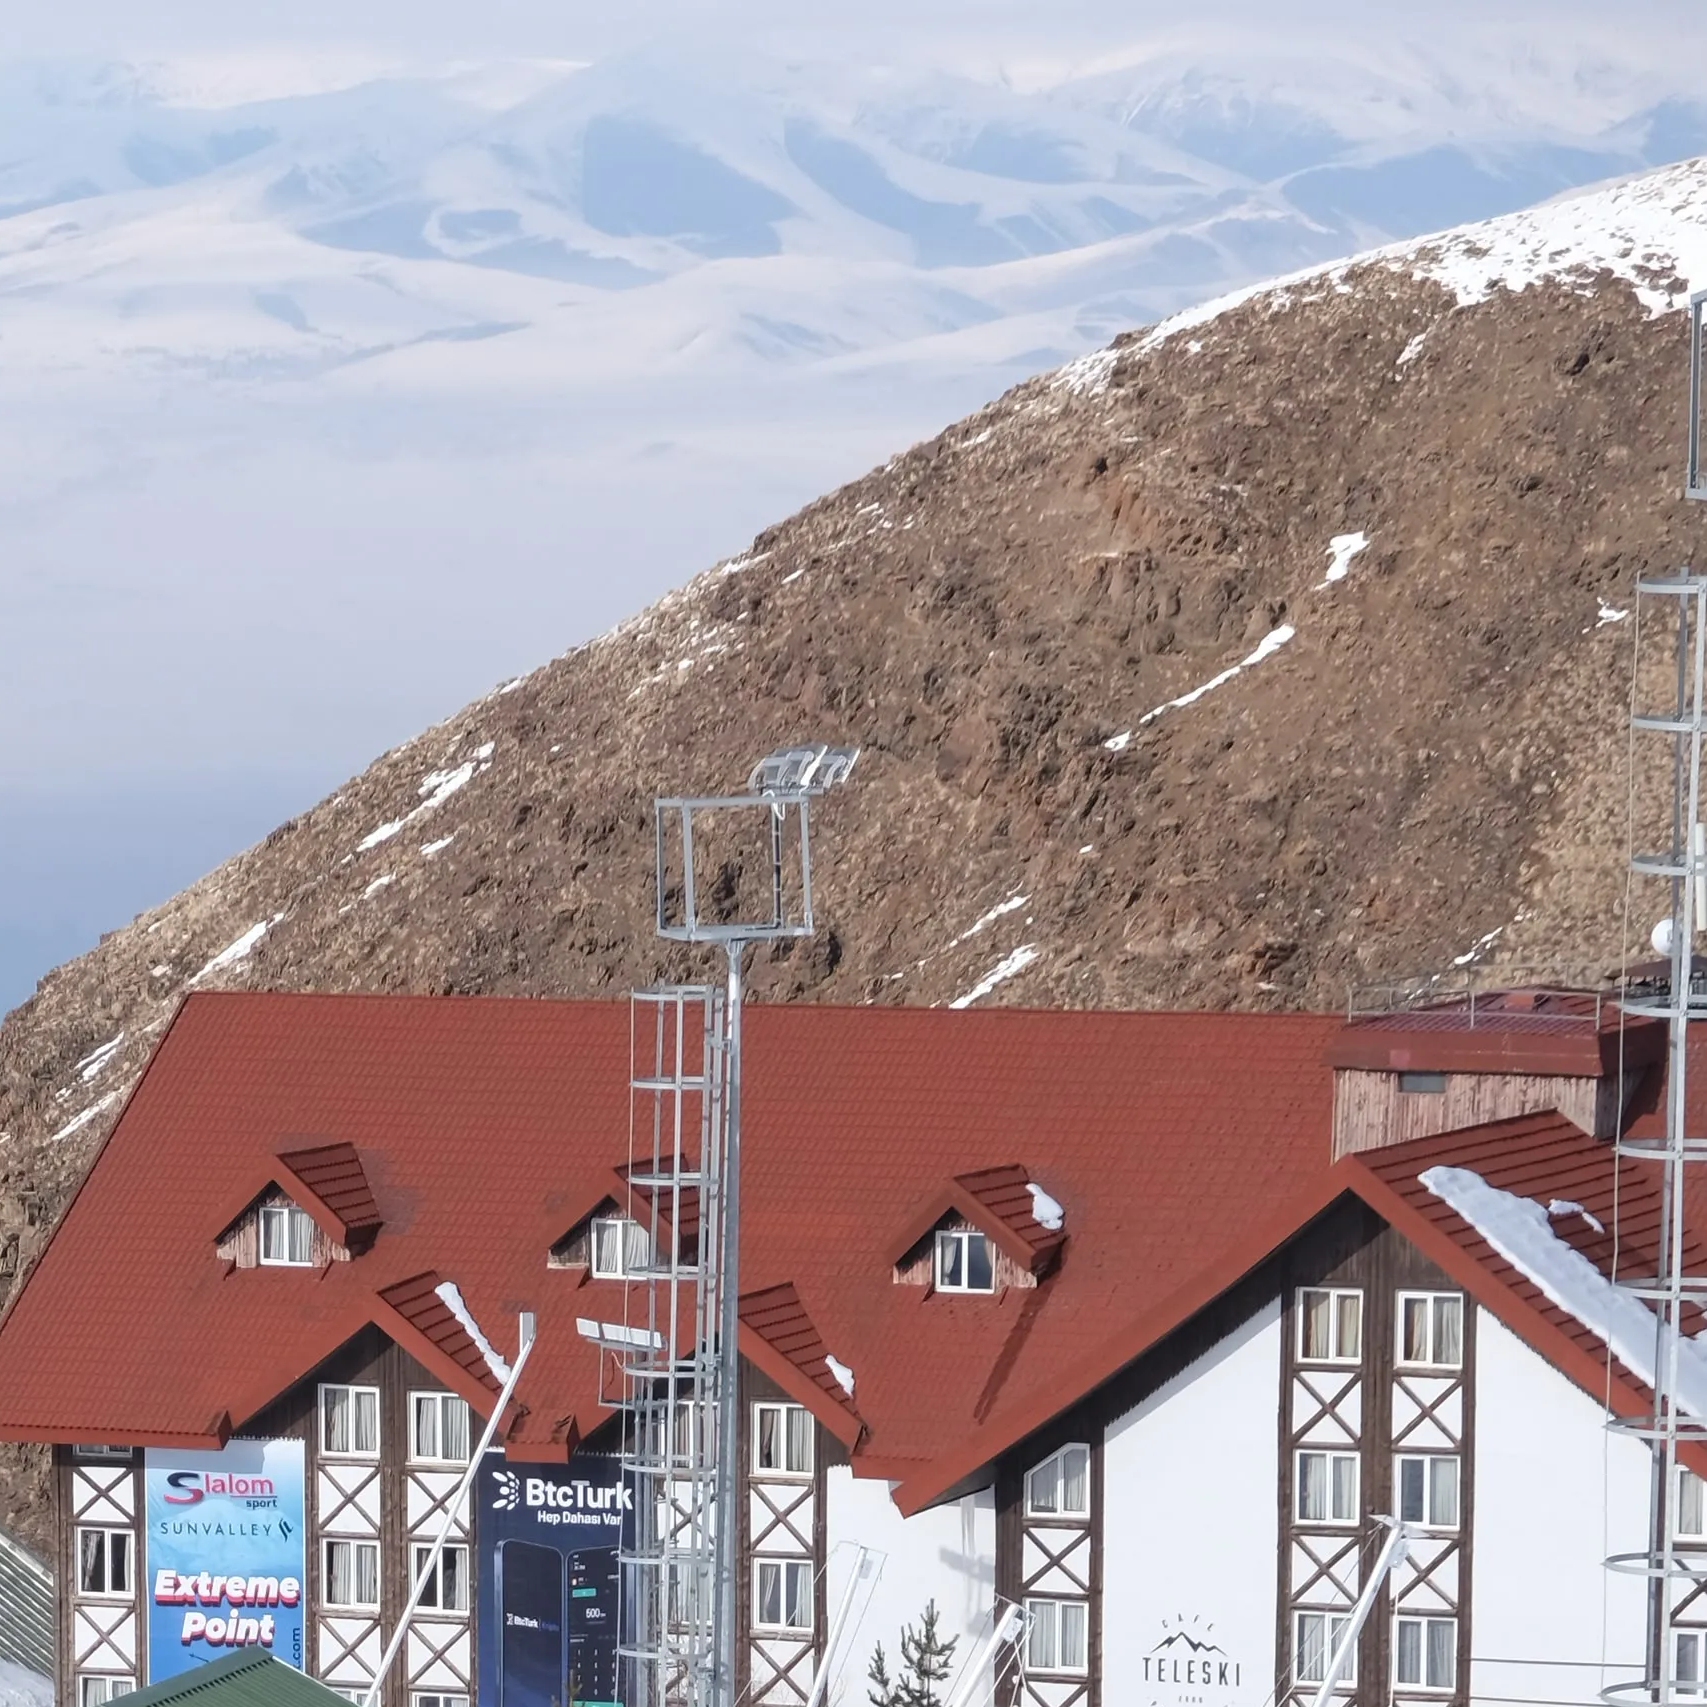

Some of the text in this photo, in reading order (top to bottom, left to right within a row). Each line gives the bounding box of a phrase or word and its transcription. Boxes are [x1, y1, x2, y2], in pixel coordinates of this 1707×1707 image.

[163, 1472, 274, 1504] Slalom
[526, 1478, 633, 1510] BtcTurk
[246, 1499, 278, 1510] sport
[537, 1510, 622, 1526] Hep Dahası Var
[160, 1522, 272, 1537] SUNVALLEY
[154, 1569, 301, 1607] Extreme
[181, 1608, 276, 1648] Point
[1142, 1657, 1240, 1687] TELESKI
